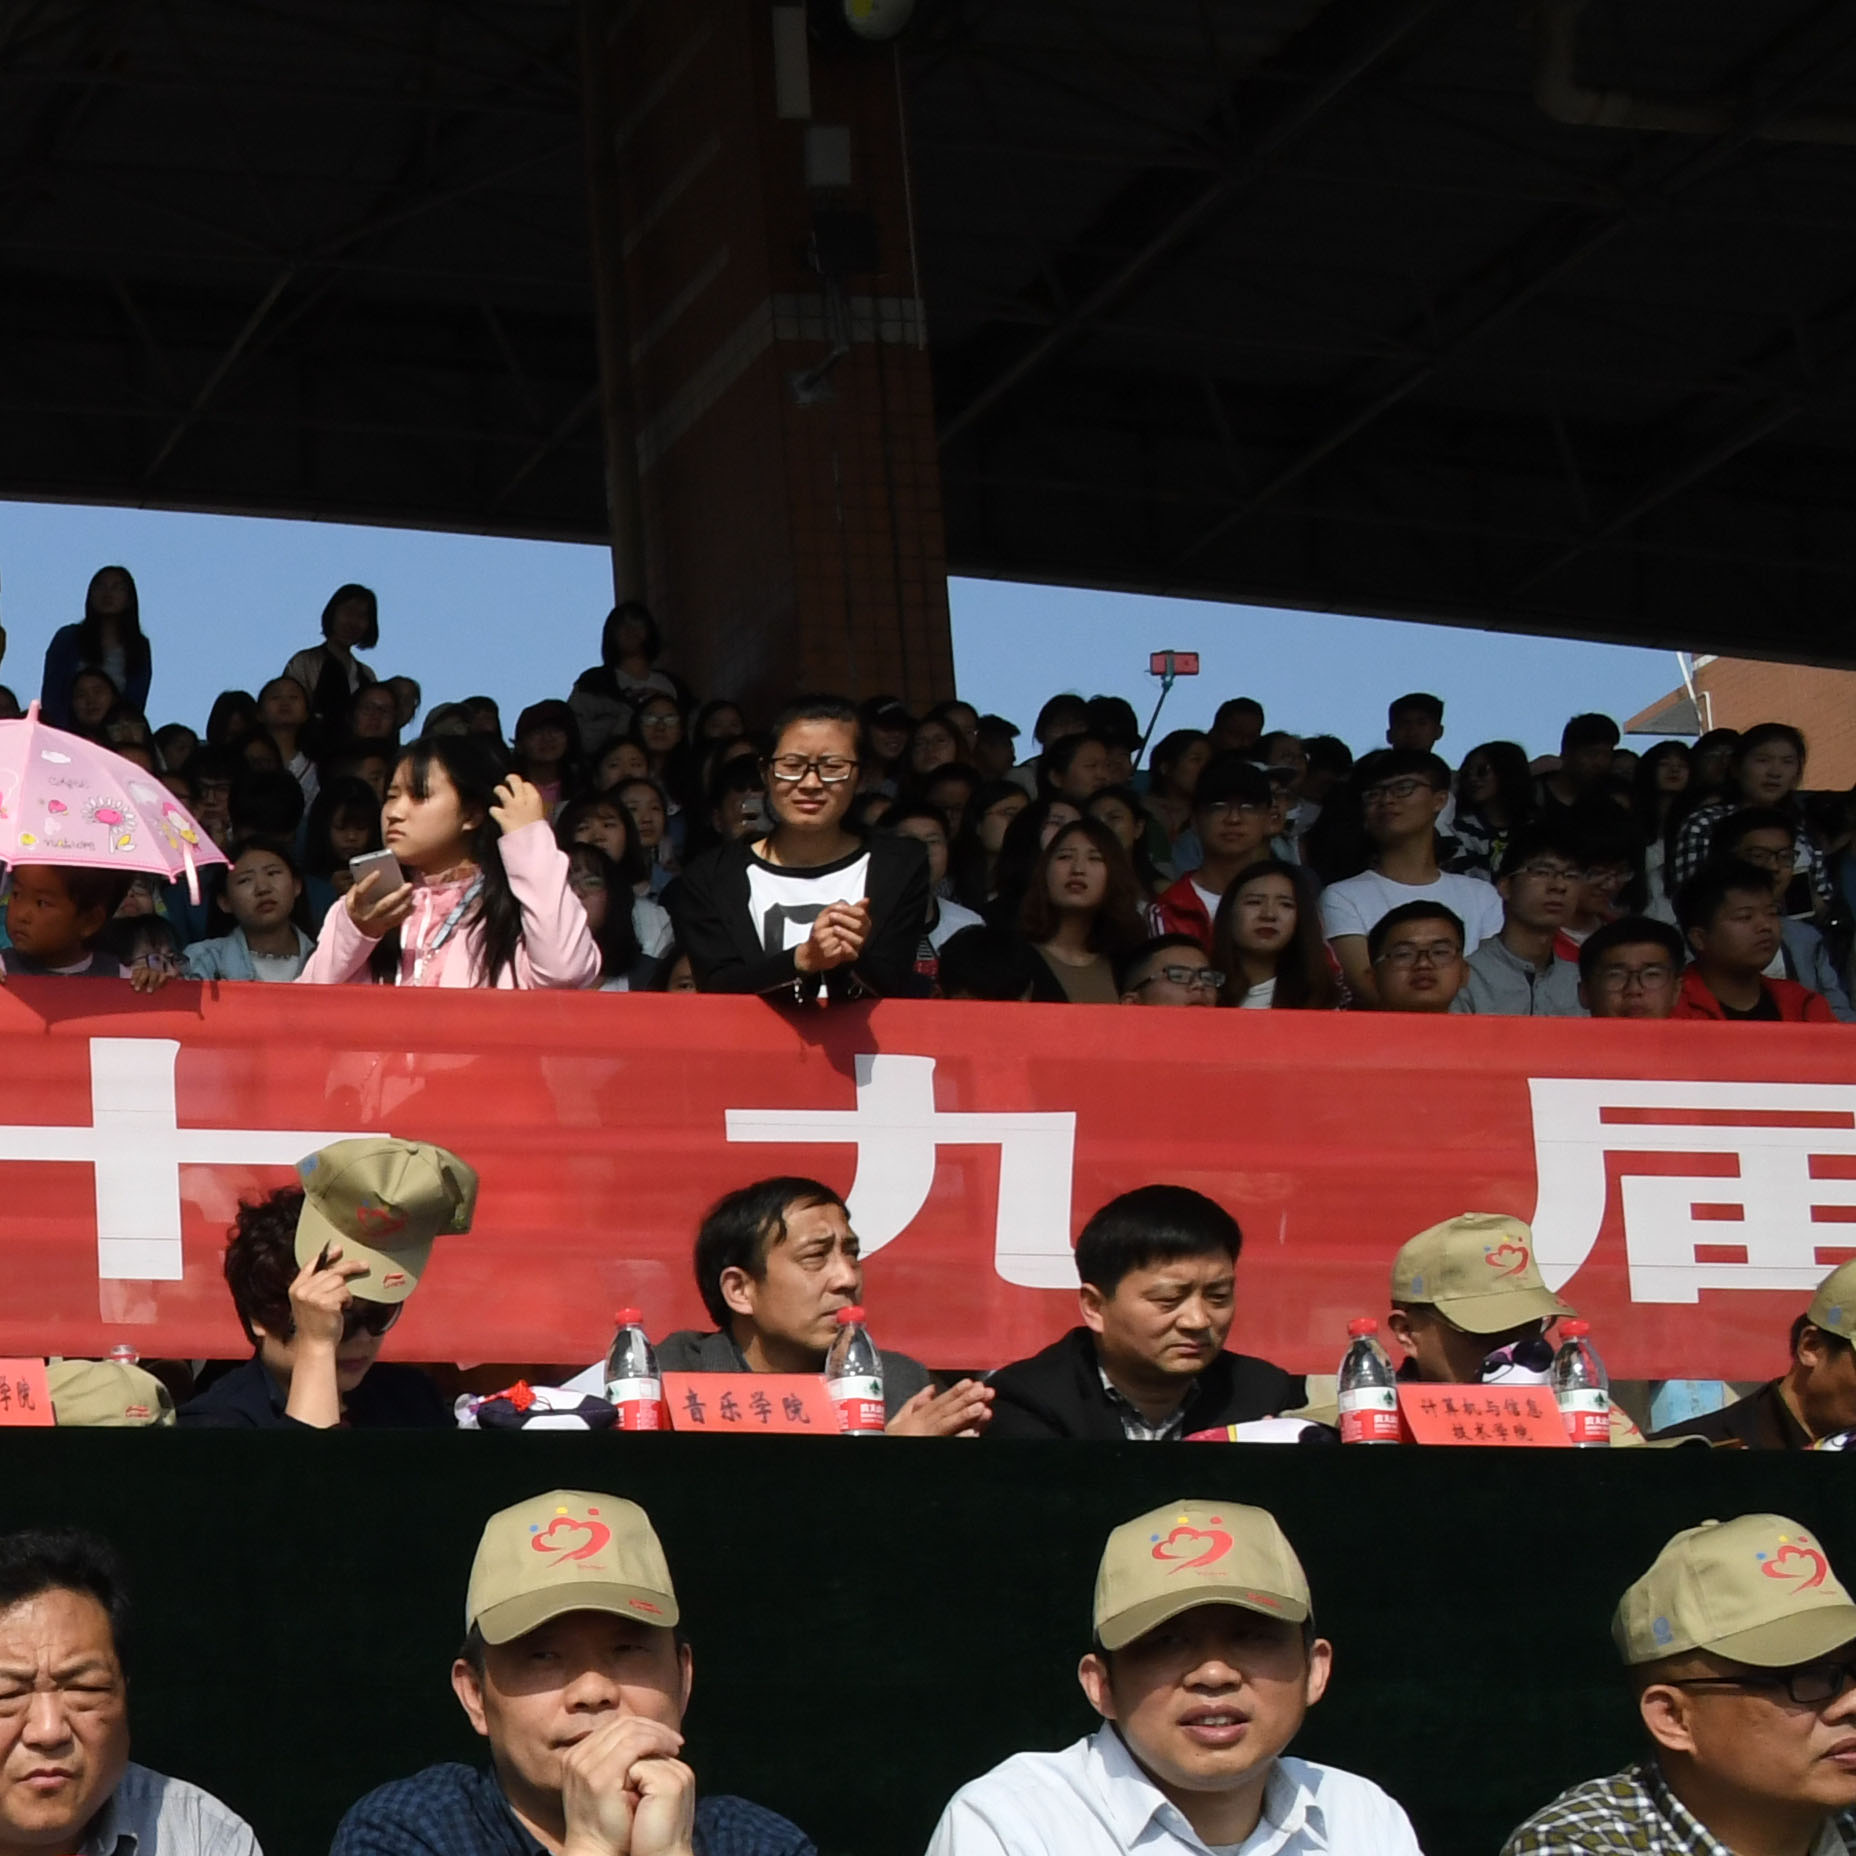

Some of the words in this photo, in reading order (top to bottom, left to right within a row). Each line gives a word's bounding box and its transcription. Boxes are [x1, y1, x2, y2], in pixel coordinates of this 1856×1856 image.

[683, 1389, 811, 1425] 音乐学院
[1420, 1398, 1543, 1419] 计算机与信息
[1451, 1423, 1535, 1442] 技术学院
